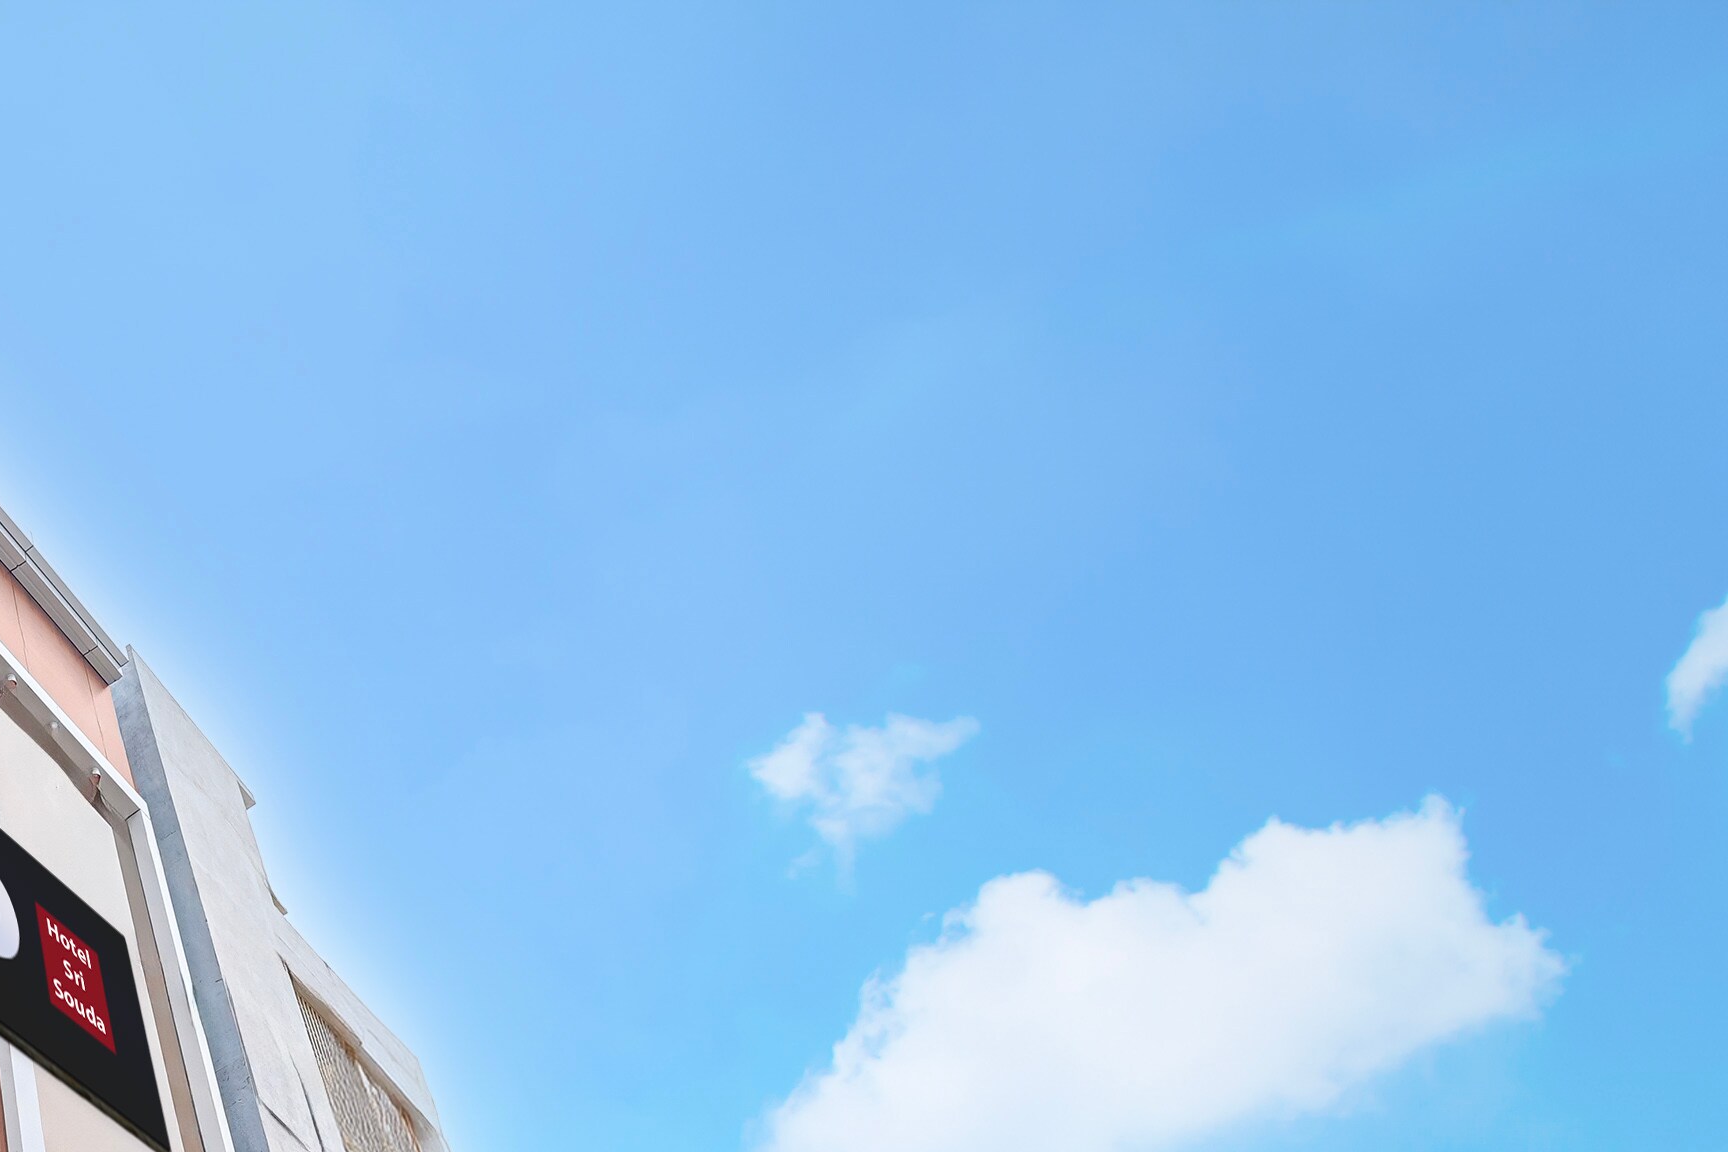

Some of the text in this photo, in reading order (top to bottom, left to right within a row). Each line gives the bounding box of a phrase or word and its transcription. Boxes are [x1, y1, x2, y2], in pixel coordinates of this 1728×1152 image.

[46, 917, 92, 970] Hotel
[62, 959, 86, 992] Sri
[53, 978, 107, 1035] Souda
